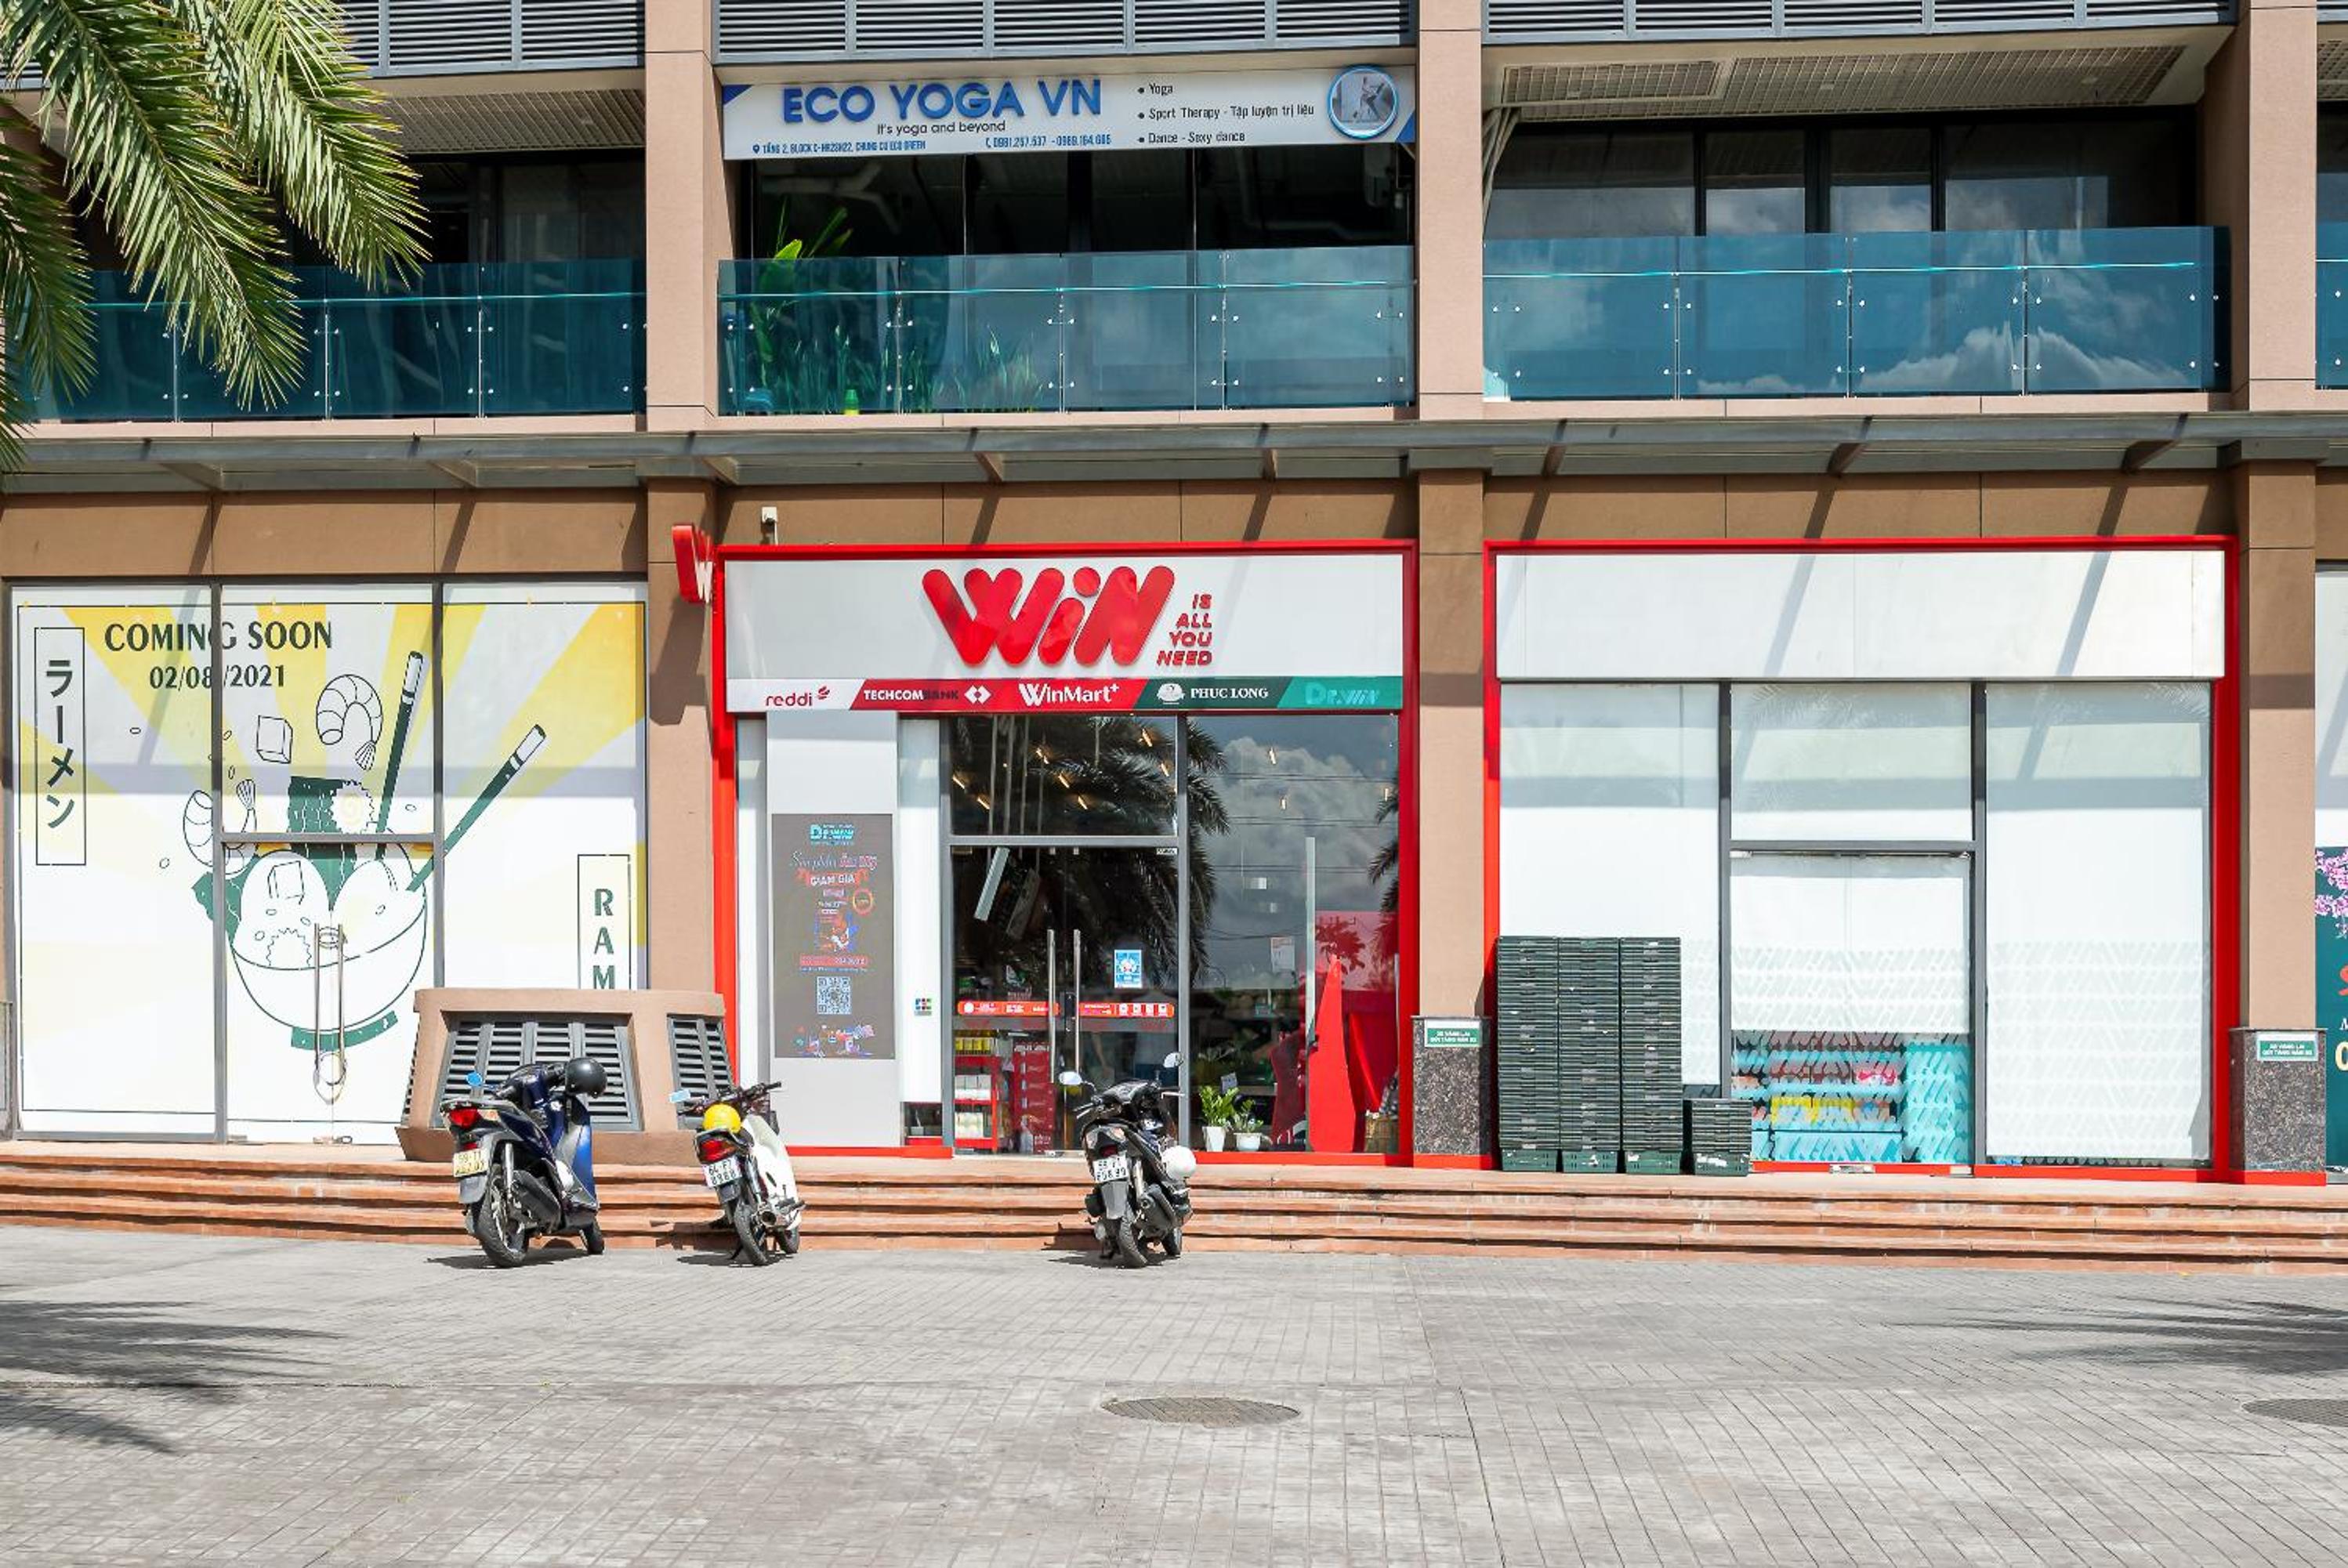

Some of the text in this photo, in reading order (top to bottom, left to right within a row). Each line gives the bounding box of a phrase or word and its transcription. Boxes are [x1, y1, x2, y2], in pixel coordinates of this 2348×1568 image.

[1148, 82, 1173, 96] Yoga
[783, 79, 1102, 124] ECO YOGA VN
[1149, 108, 1176, 121] Sport
[1181, 107, 1219, 119] Therapy
[877, 121, 1006, 136] It's yoga and beyond
[1148, 132, 1178, 143] Dance
[1192, 593, 1212, 610] IS
[1176, 613, 1212, 628] ALL
[104, 621, 332, 652] COMING SOON
[1169, 630, 1212, 647] YOU
[1157, 650, 1212, 666] NEED
[149, 664, 284, 691] 02/08/2021
[766, 690, 813, 706] reddi
[864, 688, 959, 701] TECHCOMBANK
[1230, 688, 1269, 699] LONG
[45, 659, 76, 831] ラーメン
[592, 888, 615, 990] RAM
